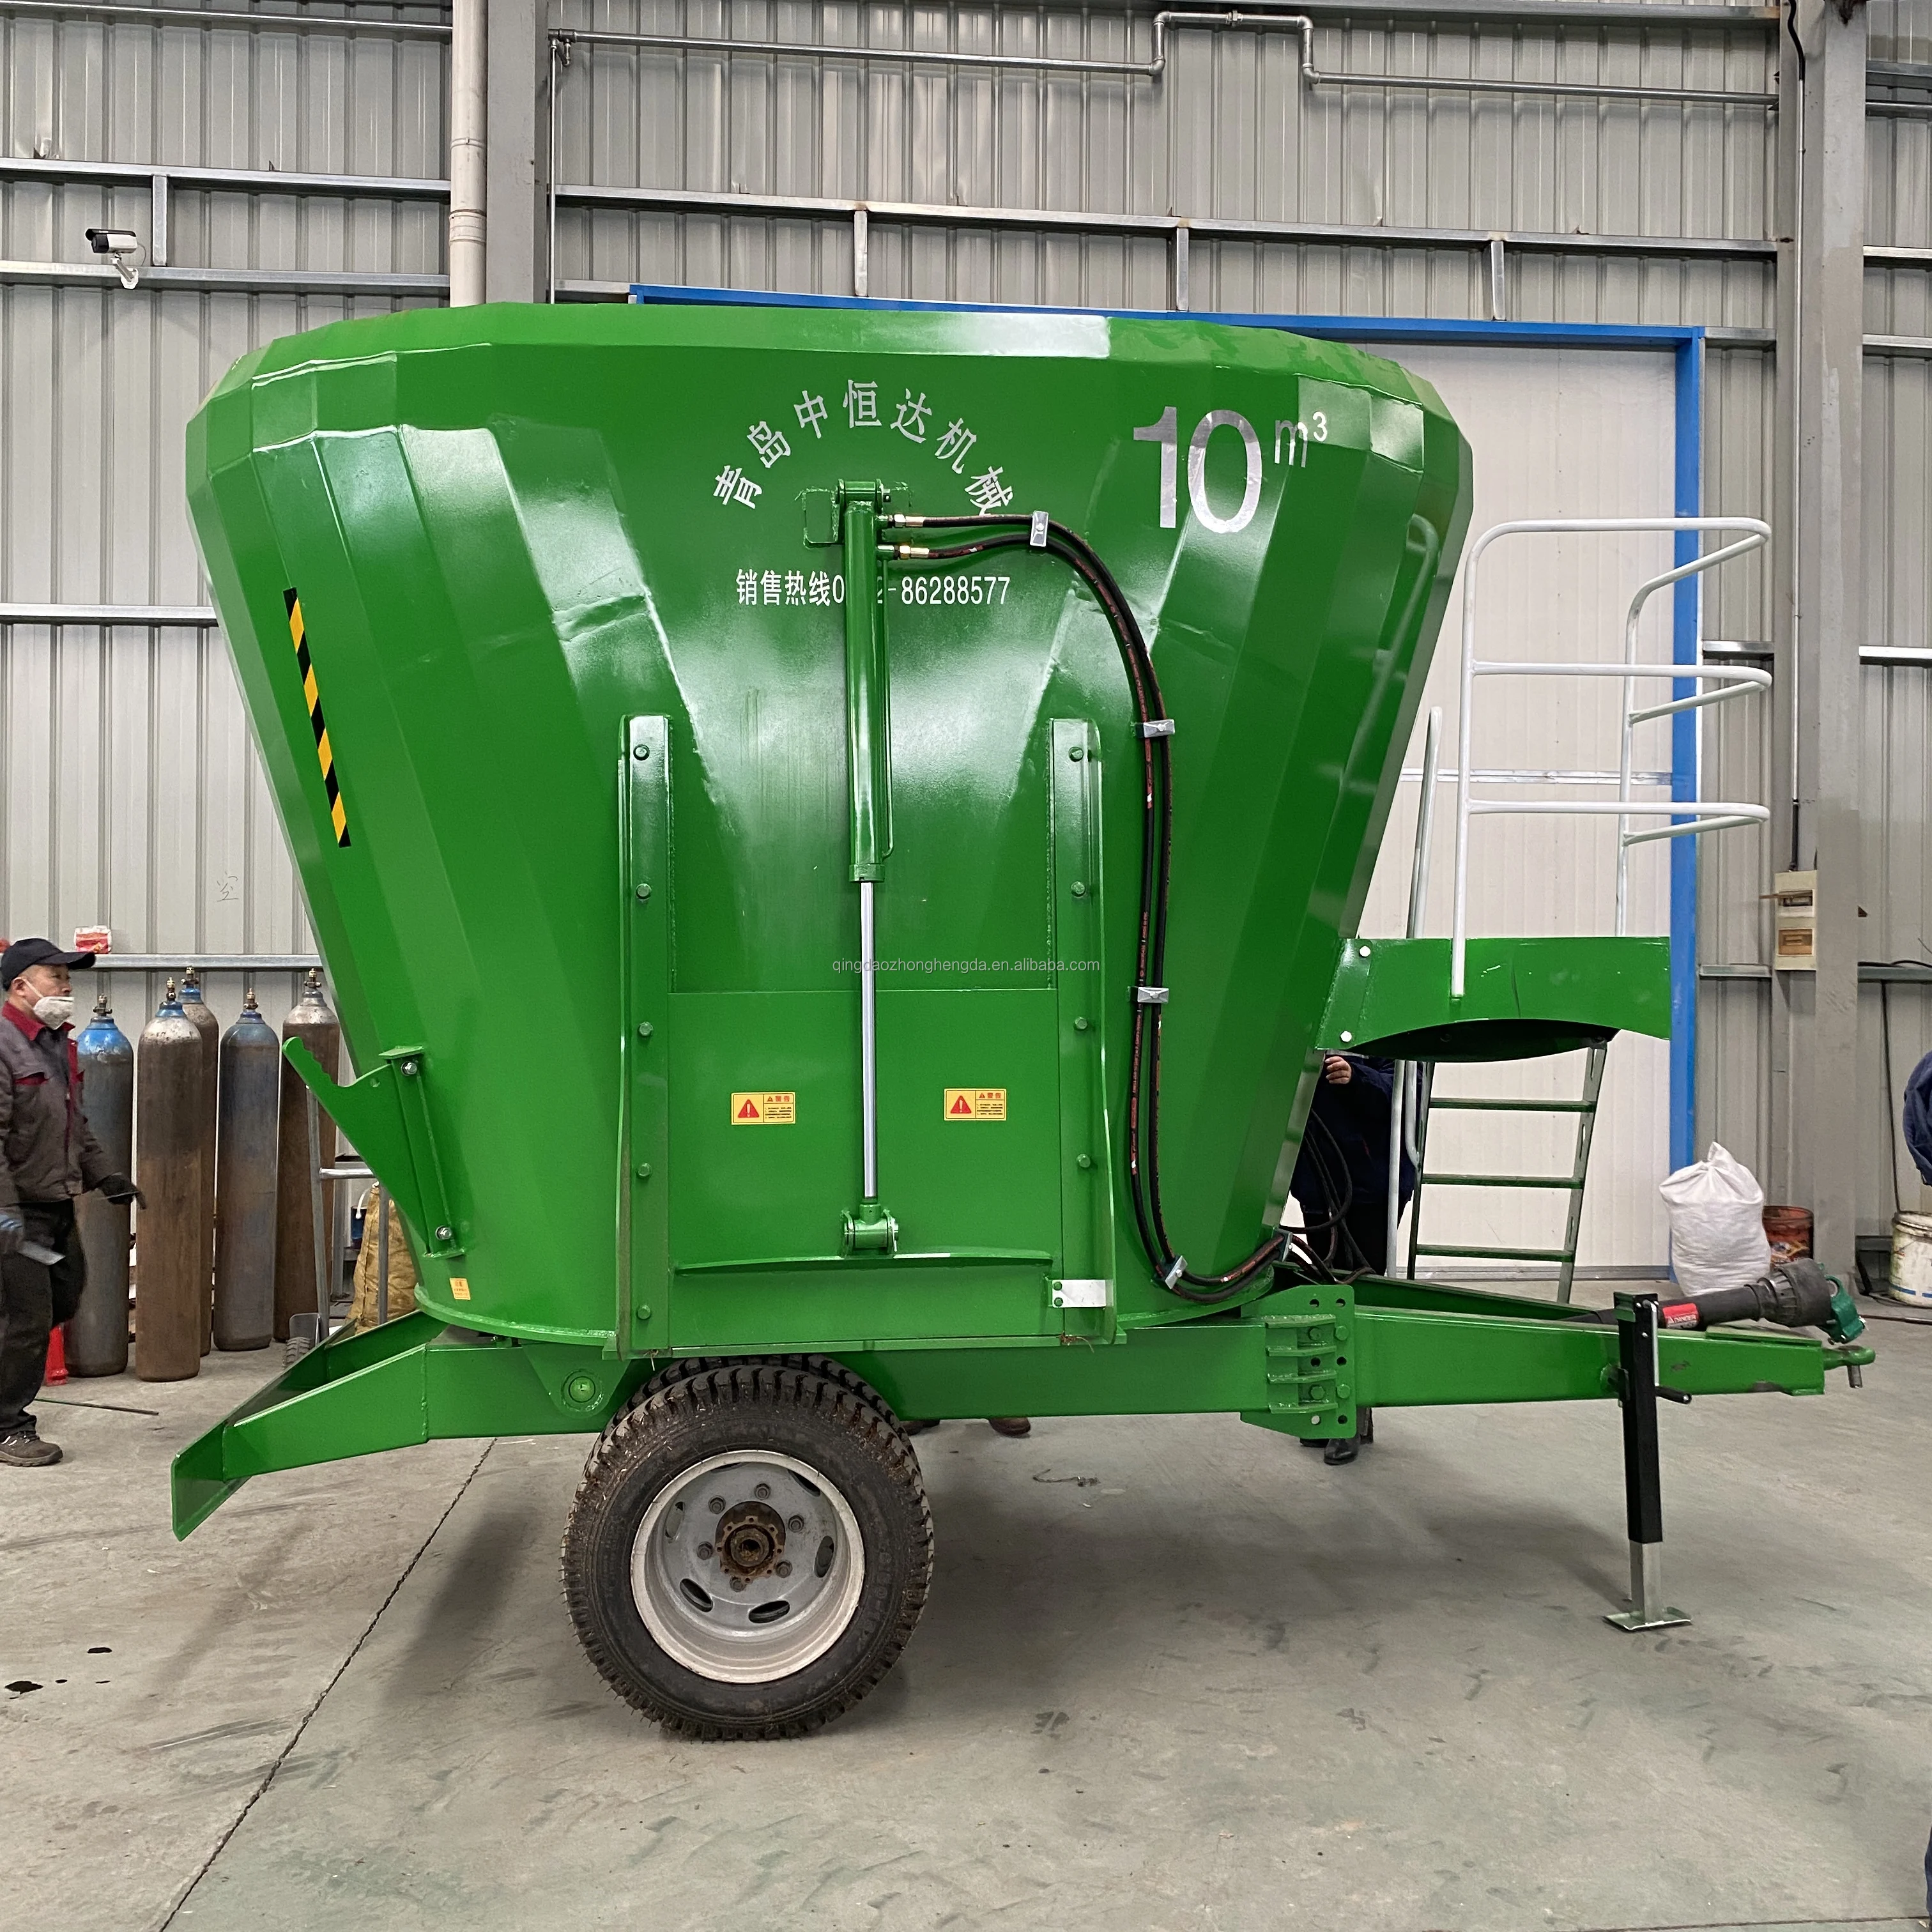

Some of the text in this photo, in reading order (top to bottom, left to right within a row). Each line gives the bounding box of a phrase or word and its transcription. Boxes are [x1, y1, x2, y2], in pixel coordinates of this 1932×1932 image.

[713, 379, 1014, 516] 青岛中恒达机械
